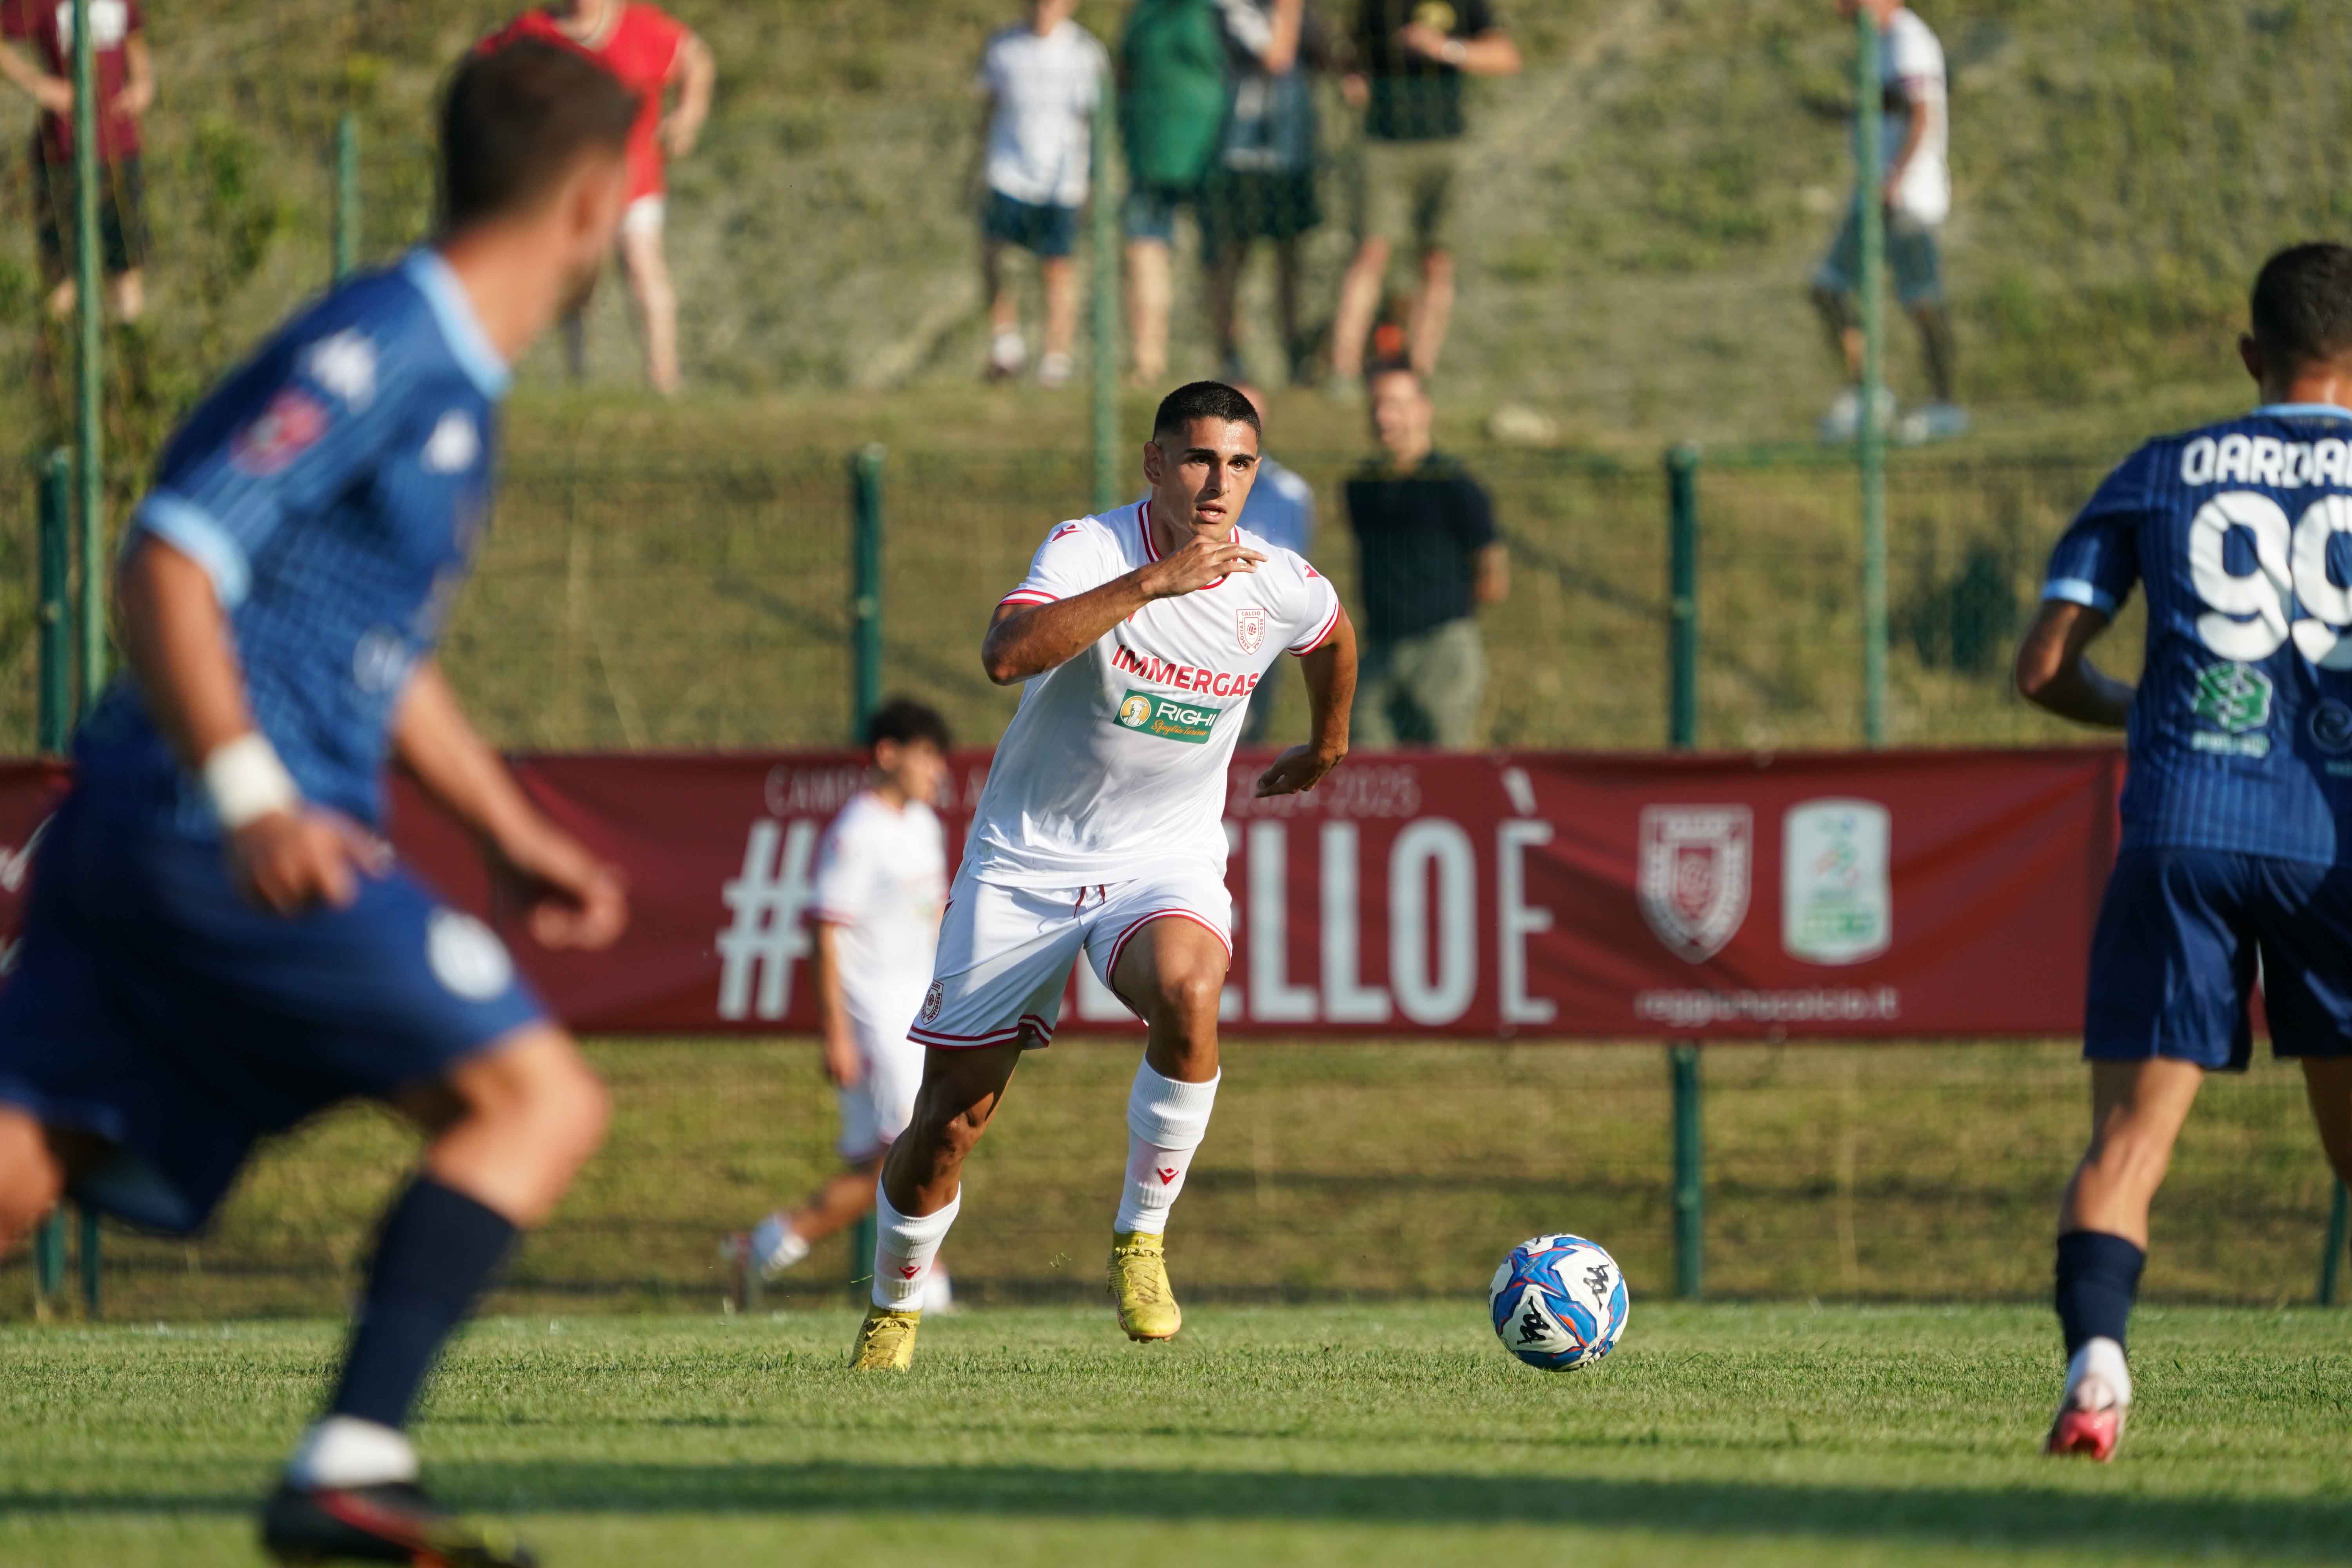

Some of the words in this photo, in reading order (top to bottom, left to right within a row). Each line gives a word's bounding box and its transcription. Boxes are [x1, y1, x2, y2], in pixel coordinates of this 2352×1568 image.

[2189, 491, 2352, 670] 99
[1252, 619, 1263, 649] REGGIANA
[1111, 644, 1259, 697] IMMERGAS
[1156, 702, 1217, 726] RIGHI
